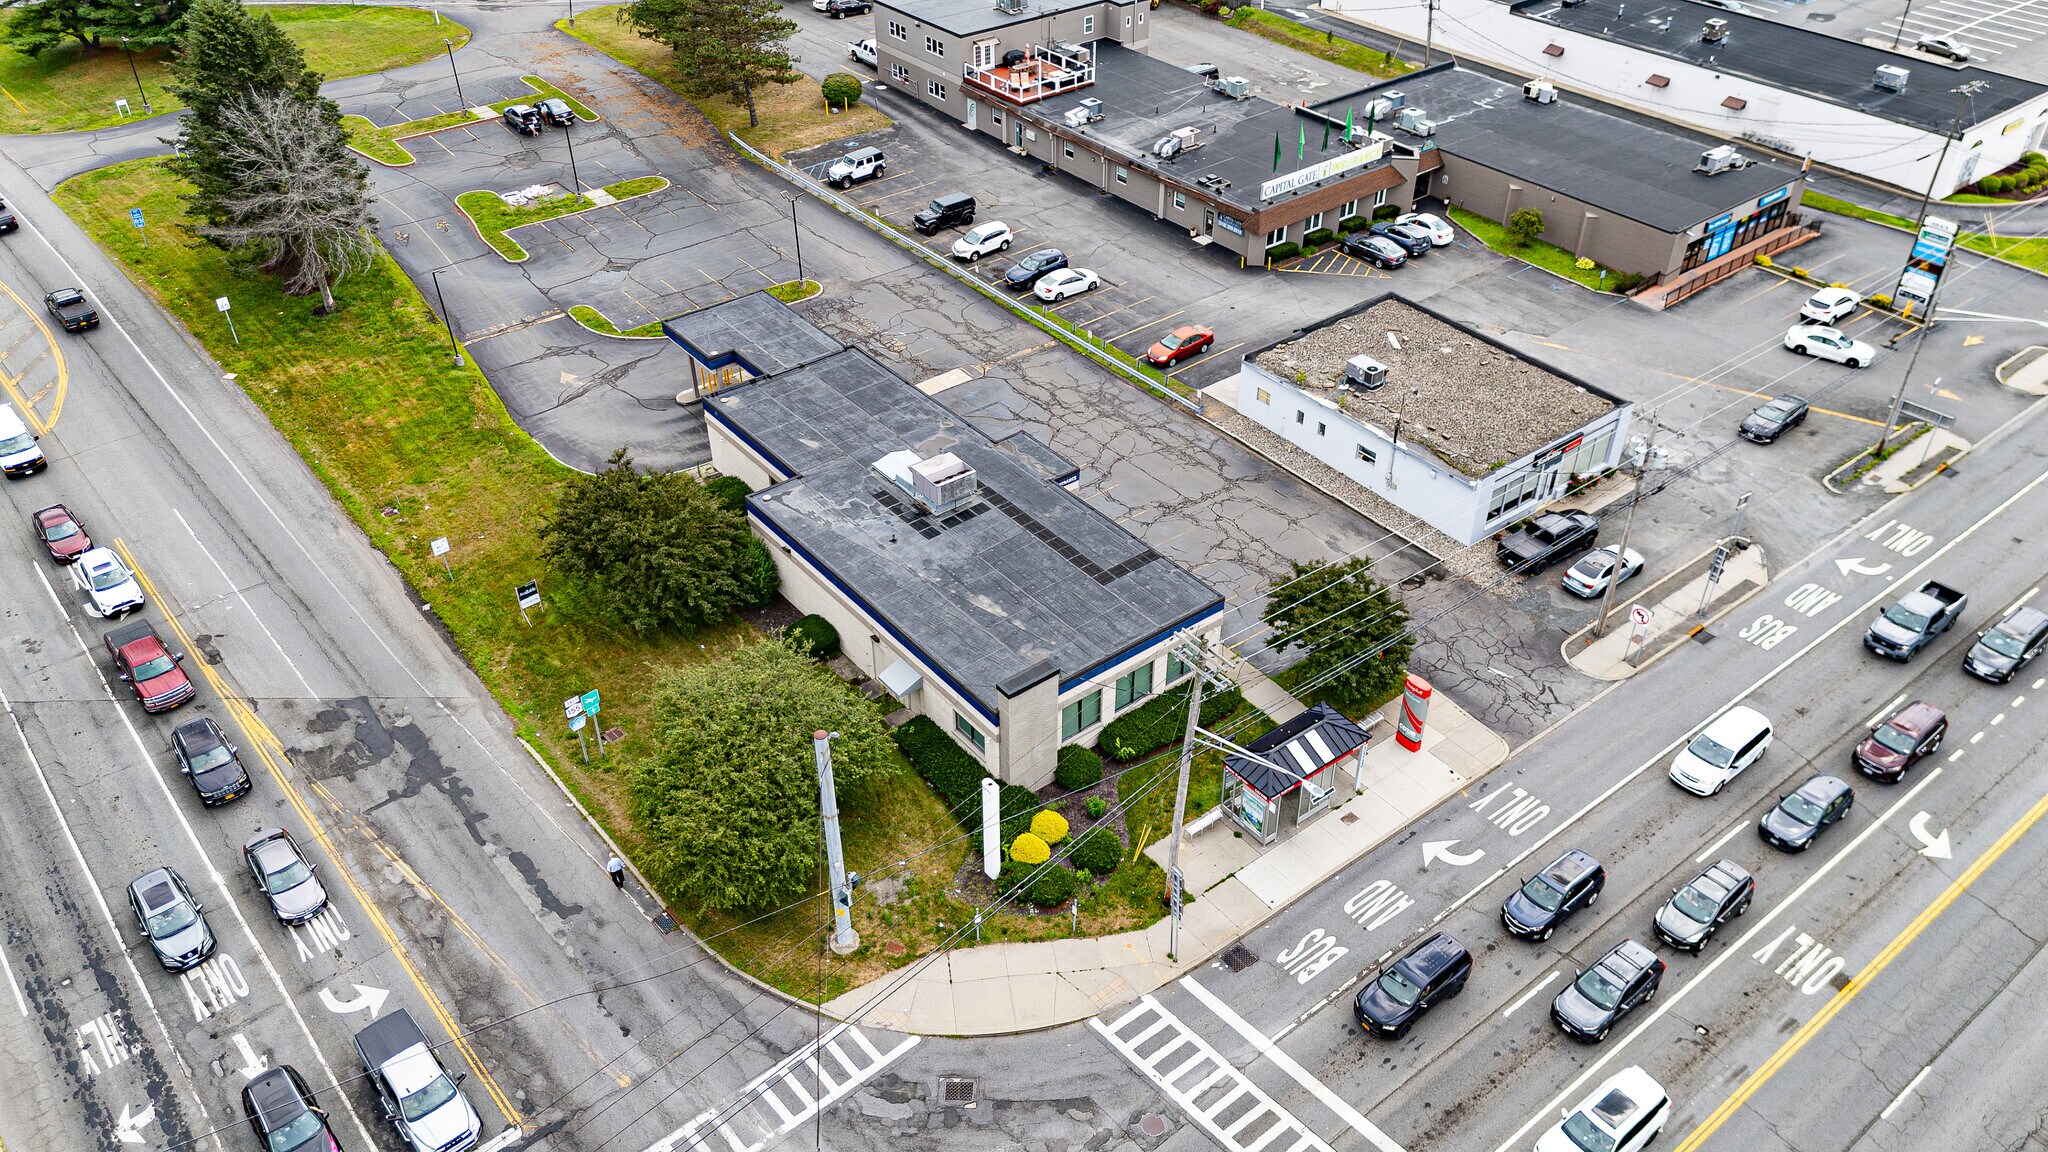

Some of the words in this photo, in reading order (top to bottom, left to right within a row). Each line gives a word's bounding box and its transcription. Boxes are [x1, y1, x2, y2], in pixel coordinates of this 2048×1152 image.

[1264, 180, 1296, 197] CAPITAL
[1298, 169, 1318, 185] GATE
[1331, 147, 1382, 172] INSURANCE
[1864, 519, 1935, 558] ONLY
[1784, 583, 1843, 618] AND
[1738, 614, 1799, 652] BUS
[567, 704, 581, 716] 155
[1468, 781, 1551, 837] ONLY
[1344, 879, 1415, 932] AND
[1276, 927, 1349, 986] BUS
[1751, 924, 1845, 996] ONLY
[180, 953, 250, 1022] ONLY
